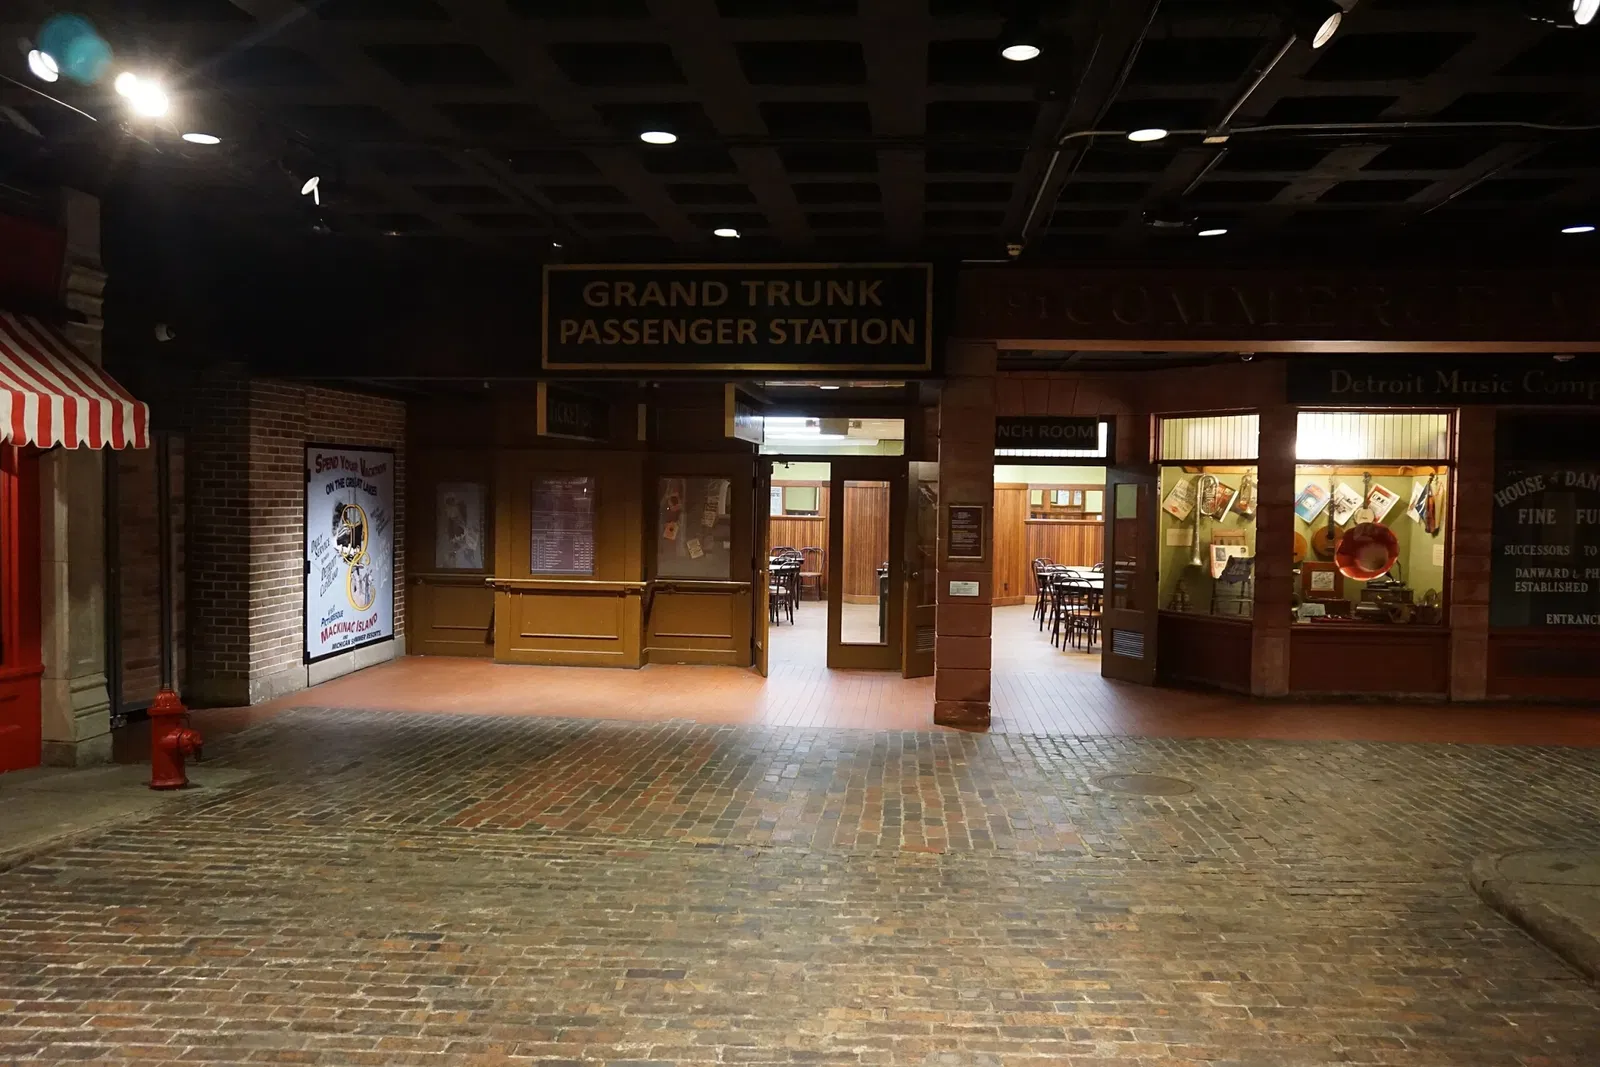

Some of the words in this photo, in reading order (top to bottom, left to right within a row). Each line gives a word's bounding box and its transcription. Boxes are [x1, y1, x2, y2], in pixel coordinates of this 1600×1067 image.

[581, 280, 729, 307] GRAND
[739, 280, 884, 307] TRUNK
[559, 318, 759, 345] PASSENGER
[767, 318, 916, 345] STATION
[1329, 370, 1425, 394] Detroit
[1435, 370, 1513, 394] Music
[998, 425, 1033, 438] NCH
[1039, 425, 1095, 438] ROOM
[325, 482, 334, 495] ON
[335, 478, 345, 490] THE
[363, 480, 377, 496] LAKES
[1494, 474, 1547, 508] HOUSE
[1517, 508, 1556, 525] FINE
[1503, 545, 1571, 556] SUCCESSORS
[1583, 545, 1598, 556] TO
[1515, 567, 1570, 579] DANWARD
[1514, 581, 1589, 593] ESTABLISHED
[320, 621, 355, 644] MACKINAC
[355, 612, 378, 632] ISLAND
[332, 640, 351, 650] MICHIGAN
